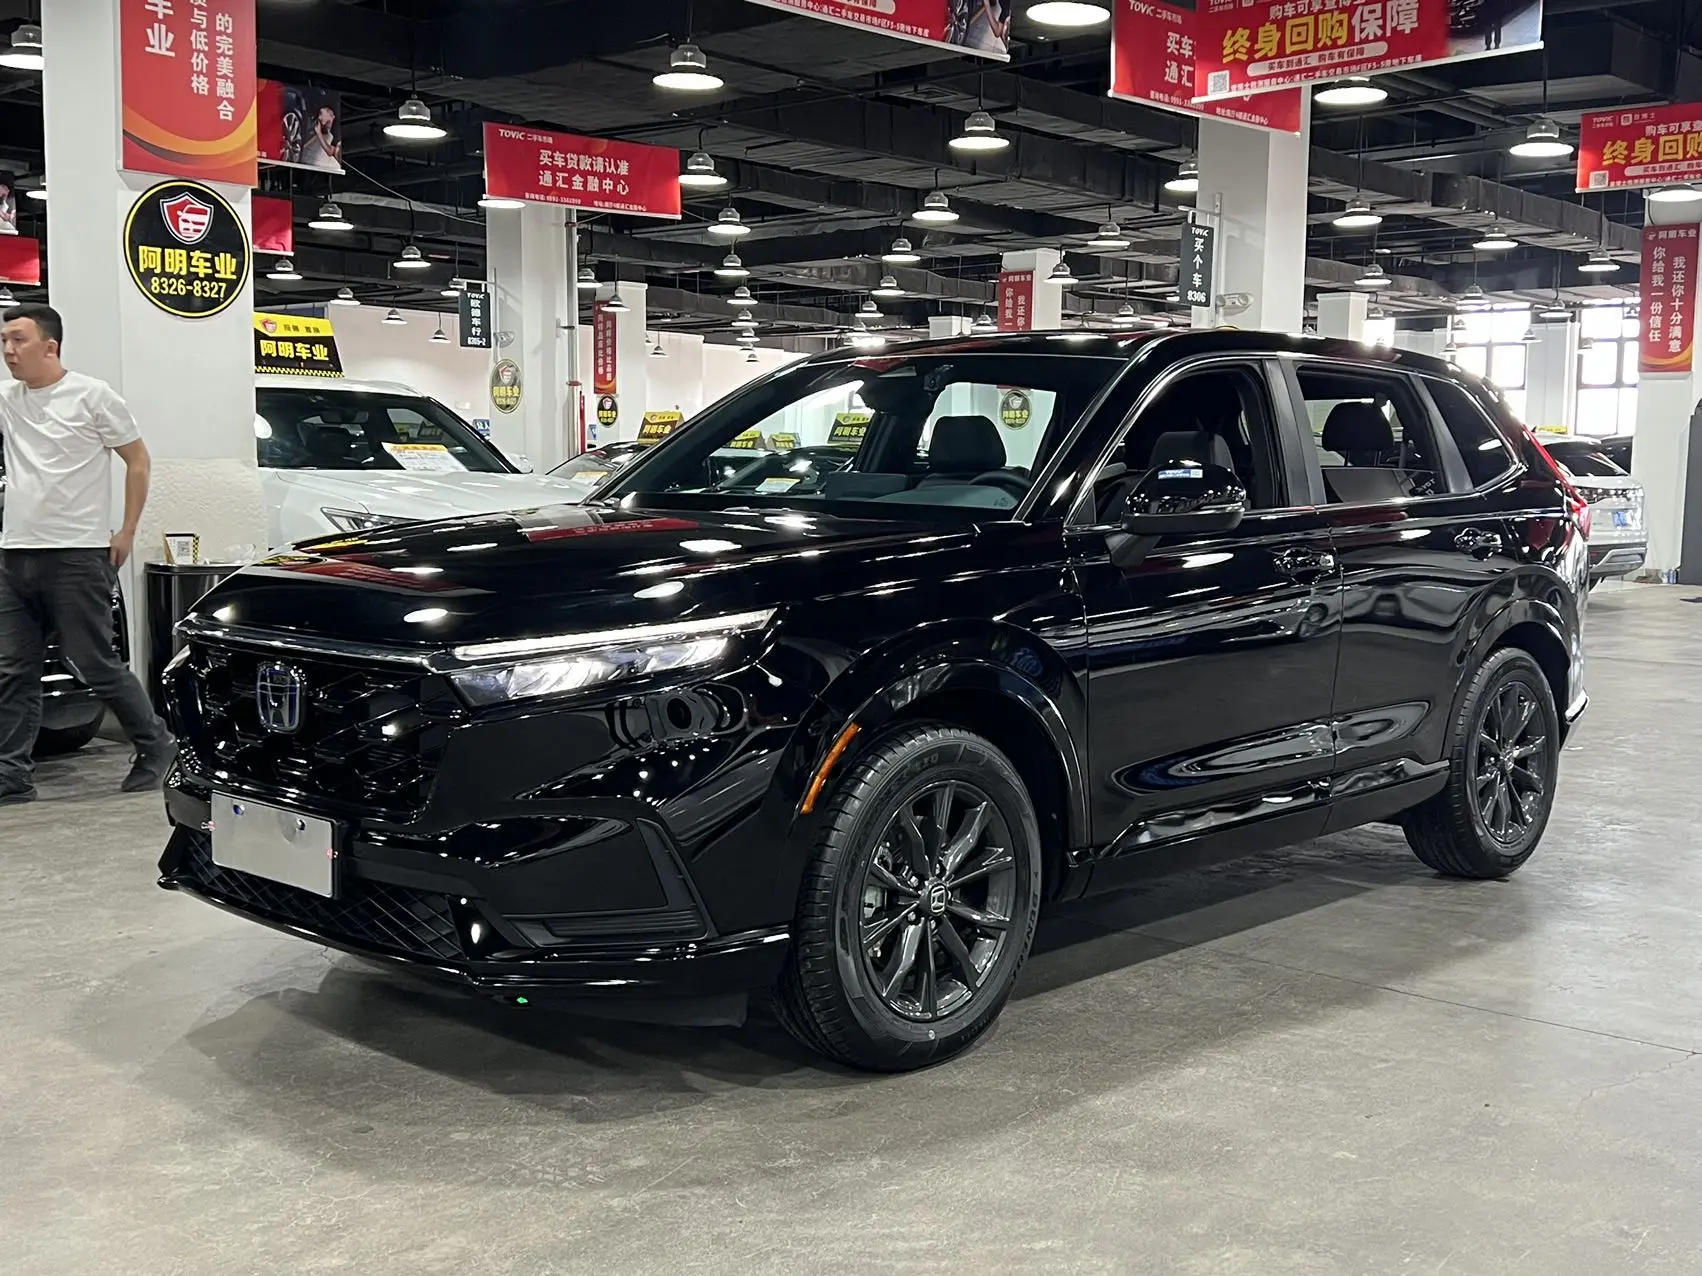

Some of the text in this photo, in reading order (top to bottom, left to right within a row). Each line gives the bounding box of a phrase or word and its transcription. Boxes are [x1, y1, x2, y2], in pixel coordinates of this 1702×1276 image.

[1269, 0, 1365, 20] 购车可享查博
[1222, 0, 1419, 63] 终身回购保障
[189, 0, 209, 96] 与低价格
[1166, 32, 1197, 60] 买车
[1267, 46, 1365, 71] 买车到通汇 购车有保障
[215, 12, 235, 121] 的完美融合
[1164, 60, 1194, 88] 通汇
[499, 129, 526, 140] TOVIC
[1602, 131, 1702, 166] 终身回购
[539, 149, 629, 176] 买车贷款请认准
[539, 170, 629, 196] 通汇金融中心
[138, 245, 237, 280] 阿明车业
[1192, 237, 1205, 288] 买个车
[151, 277, 227, 299] 8326-8327
[1187, 290, 1206, 303] 8306
[1648, 246, 1666, 342] 你给我一份信任
[1017, 295, 1026, 331] 我还你
[1668, 256, 1687, 353] 我还你十分满意
[260, 339, 330, 361] 阿明车业
